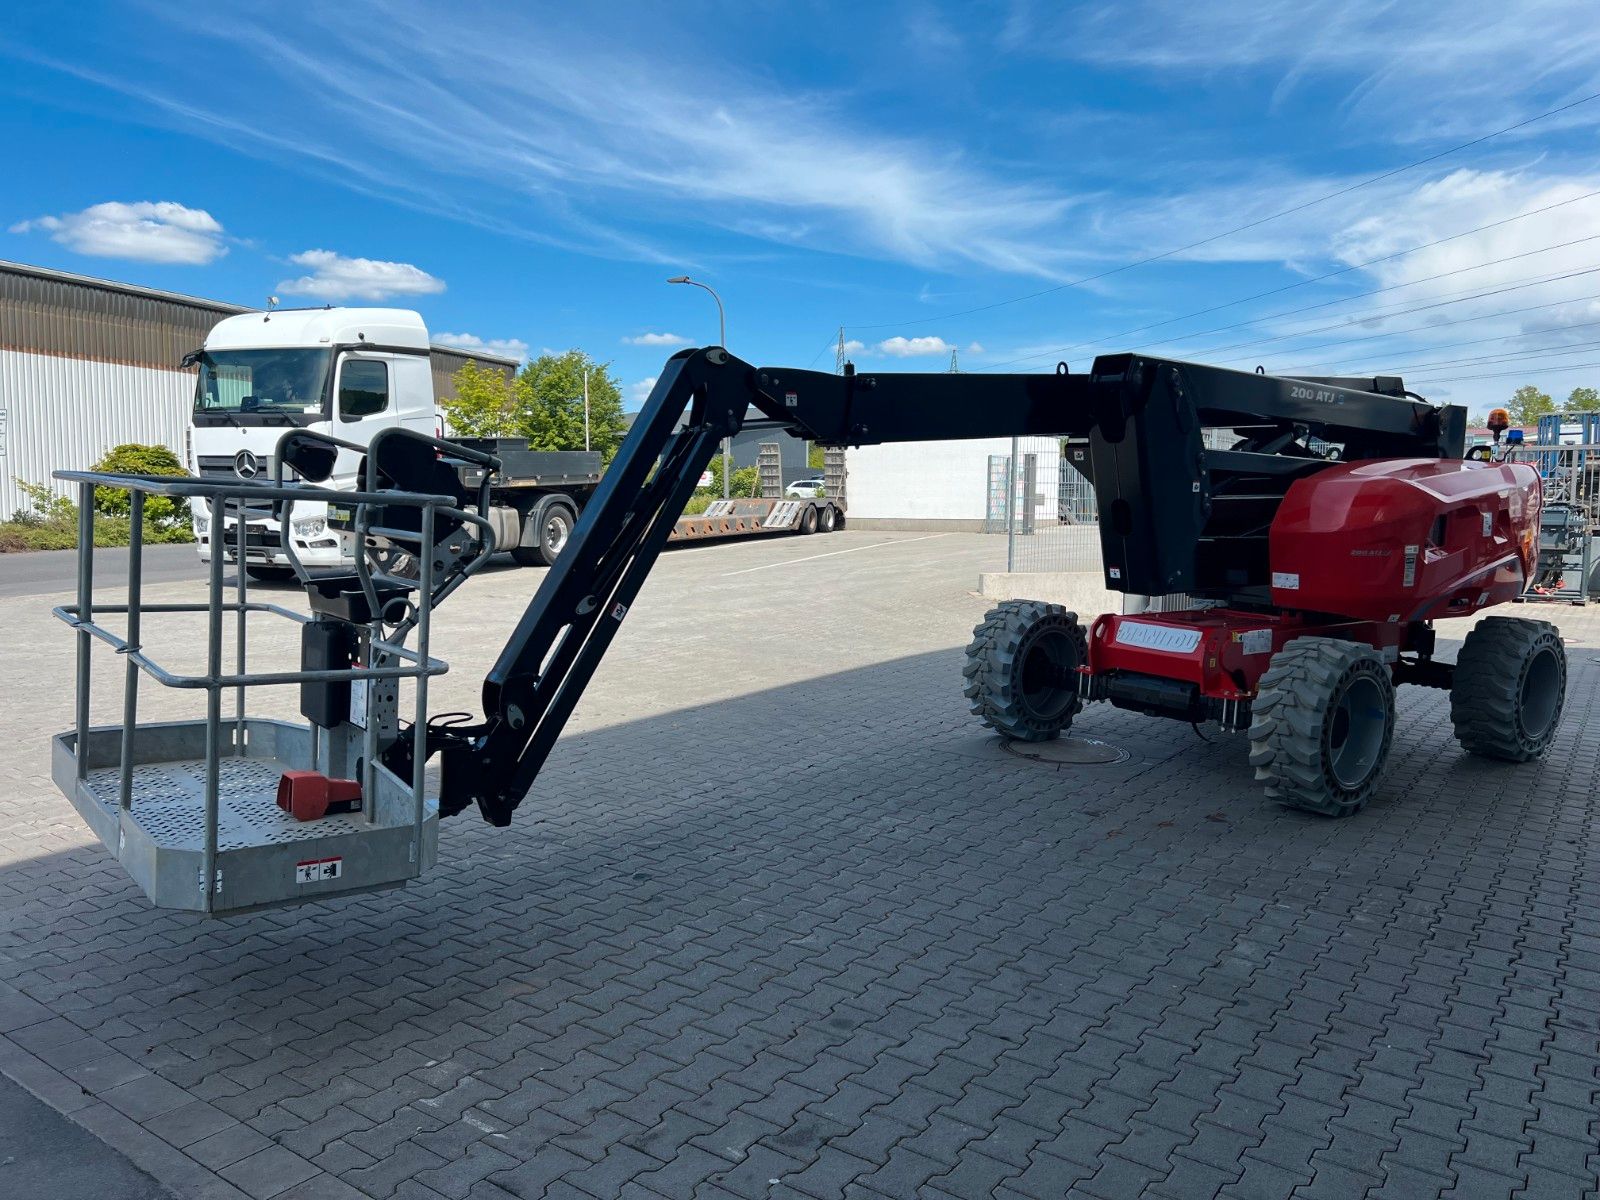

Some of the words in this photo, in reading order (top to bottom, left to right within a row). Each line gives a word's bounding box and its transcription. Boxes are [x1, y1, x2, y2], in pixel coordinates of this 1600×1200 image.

[1290, 386, 1314, 400] 200
[1316, 390, 1335, 403] ATJ
[1116, 624, 1200, 650] MANITOU
